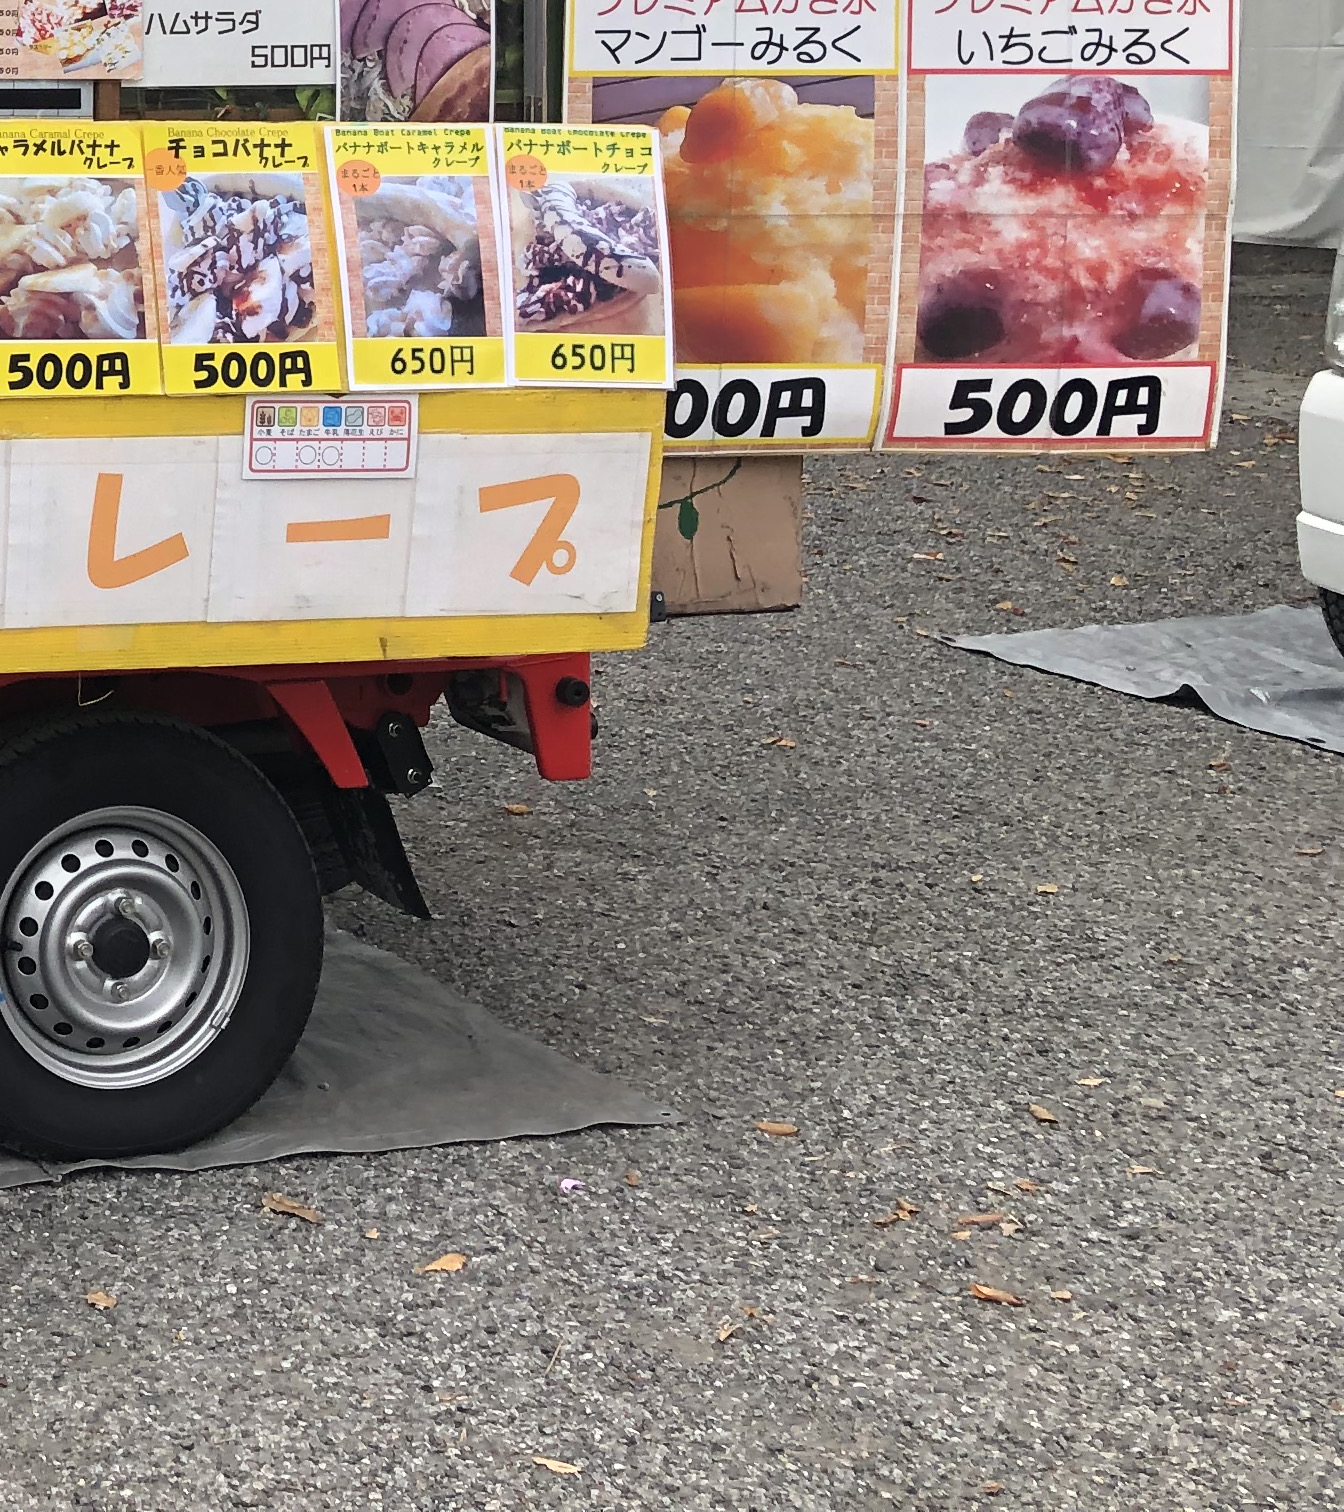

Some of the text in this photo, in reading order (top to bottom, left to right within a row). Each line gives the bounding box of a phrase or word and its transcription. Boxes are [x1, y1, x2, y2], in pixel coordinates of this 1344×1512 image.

[145, 9, 261, 36] ハムサラダ
[250, 44, 331, 68] 500円
[595, 24, 863, 65] マンゴーみるく
[957, 26, 1191, 66] いちごみるく
[167, 138, 293, 159] チョコバナナ
[335, 141, 485, 155] バナナボートキャラメル
[507, 139, 653, 158] バナナボートチョコ
[83, 156, 135, 169] クレープ
[259, 155, 310, 169] クレープ
[432, 156, 480, 168] クレープ
[601, 162, 648, 175] クレープ
[7, 351, 131, 391] 500円
[193, 349, 313, 389] 500円
[390, 344, 475, 377] 650円
[551, 342, 637, 374] 650円
[664, 377, 826, 438] 00円
[943, 375, 1162, 437] 500円
